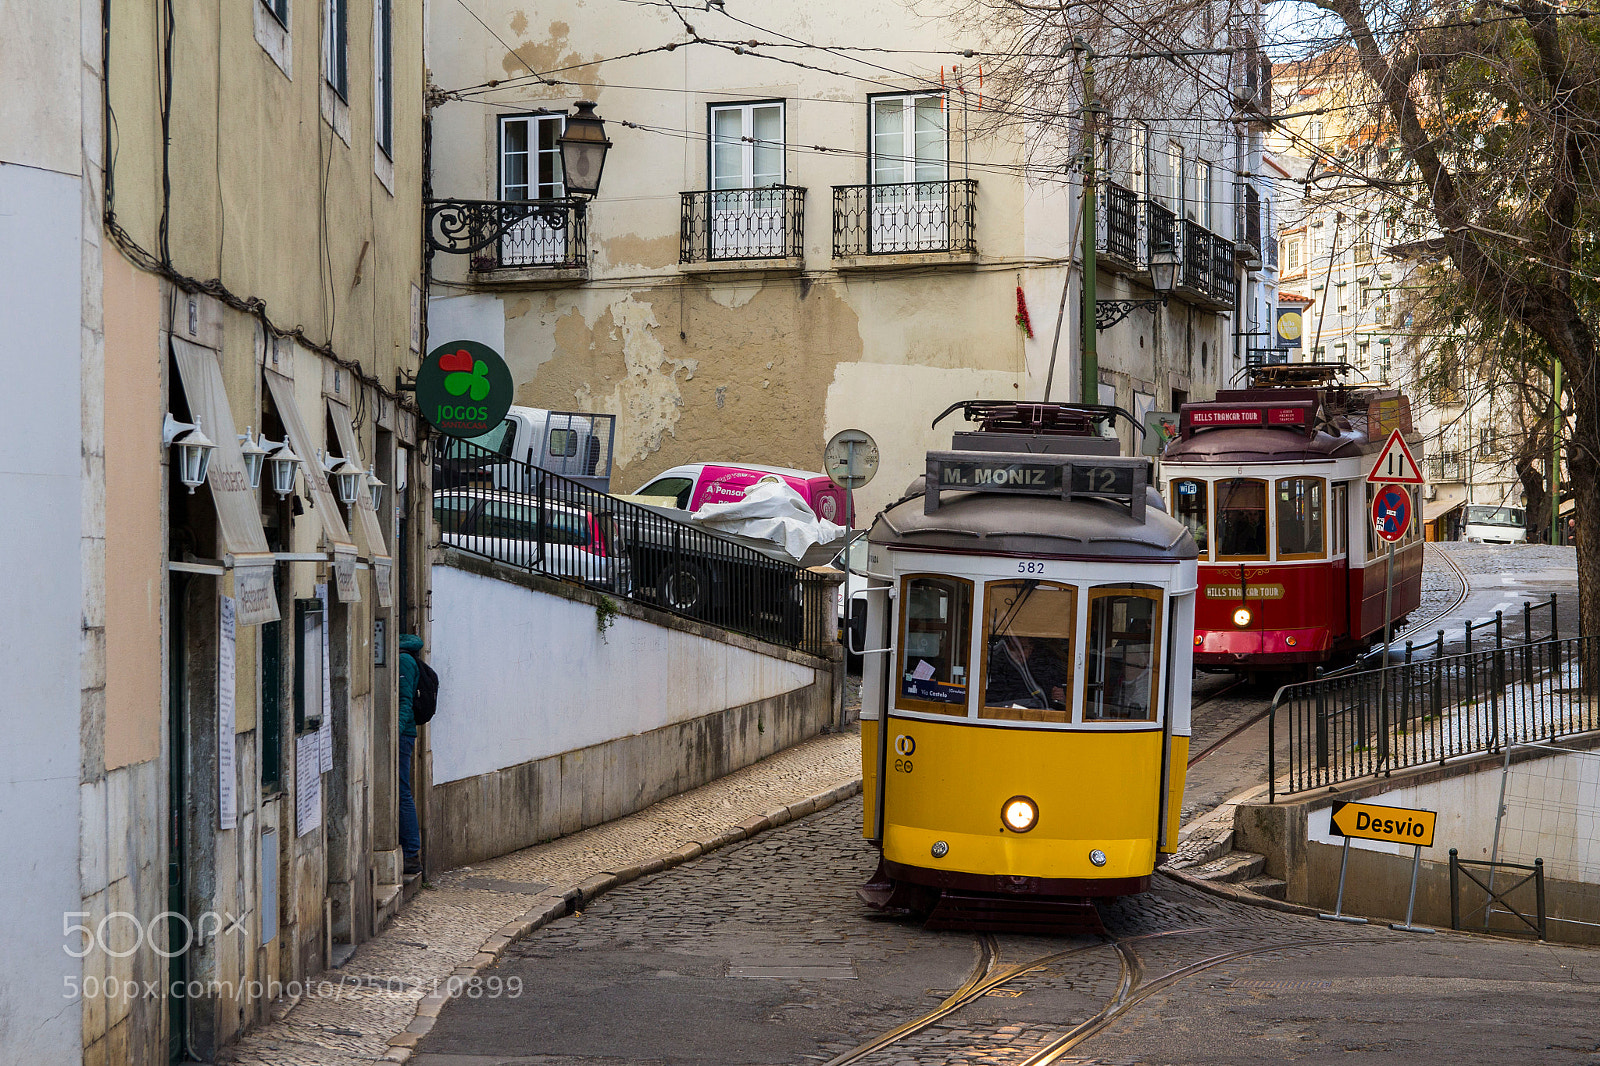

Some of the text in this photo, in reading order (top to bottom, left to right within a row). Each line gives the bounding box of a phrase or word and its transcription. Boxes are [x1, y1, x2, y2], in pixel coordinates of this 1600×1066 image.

[436, 404, 488, 424] JOGOS
[1193, 413, 1213, 422] HILLS
[1241, 412, 1258, 420] TOUR
[441, 421, 488, 430] SANTACASA
[943, 468, 1046, 485] M. MONIZ
[1086, 468, 1116, 492] 12
[706, 485, 745, 497] A Pensar
[1017, 561, 1045, 574] 582
[1207, 587, 1279, 597] HILLS TRACAR TOUR
[1355, 811, 1425, 838] Desvio
